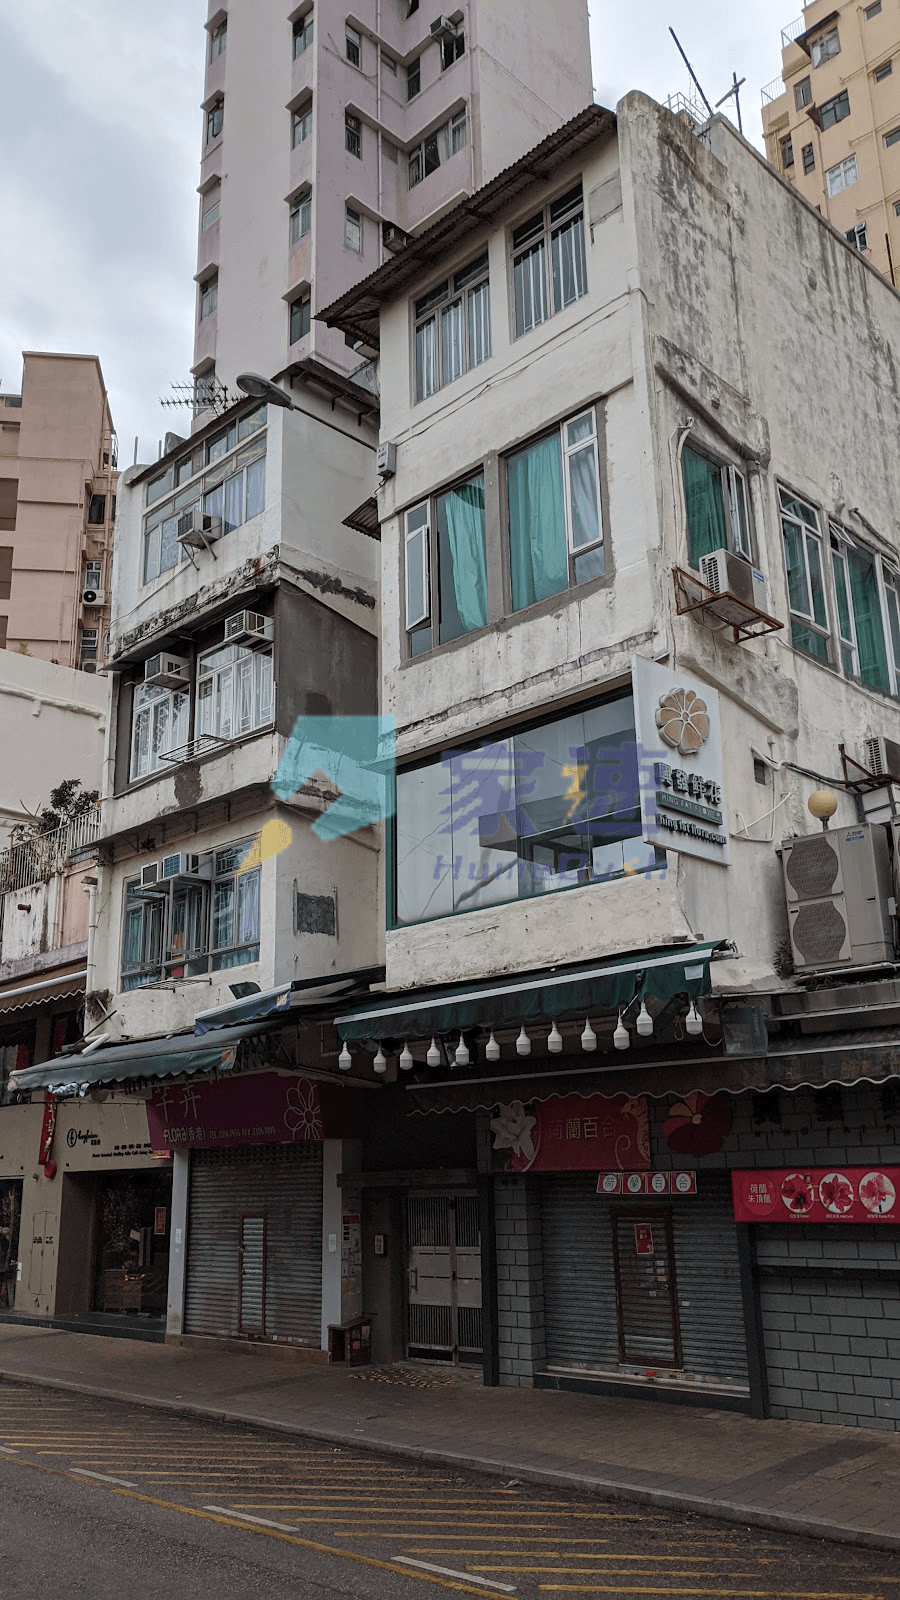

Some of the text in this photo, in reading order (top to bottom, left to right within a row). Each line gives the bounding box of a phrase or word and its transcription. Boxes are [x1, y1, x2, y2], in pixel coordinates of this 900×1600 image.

[655, 761, 722, 805] 興發鮮花
[661, 793, 721, 818] HING FAT FLOWER
[549, 1114, 617, 1140] 荷蘭百合
